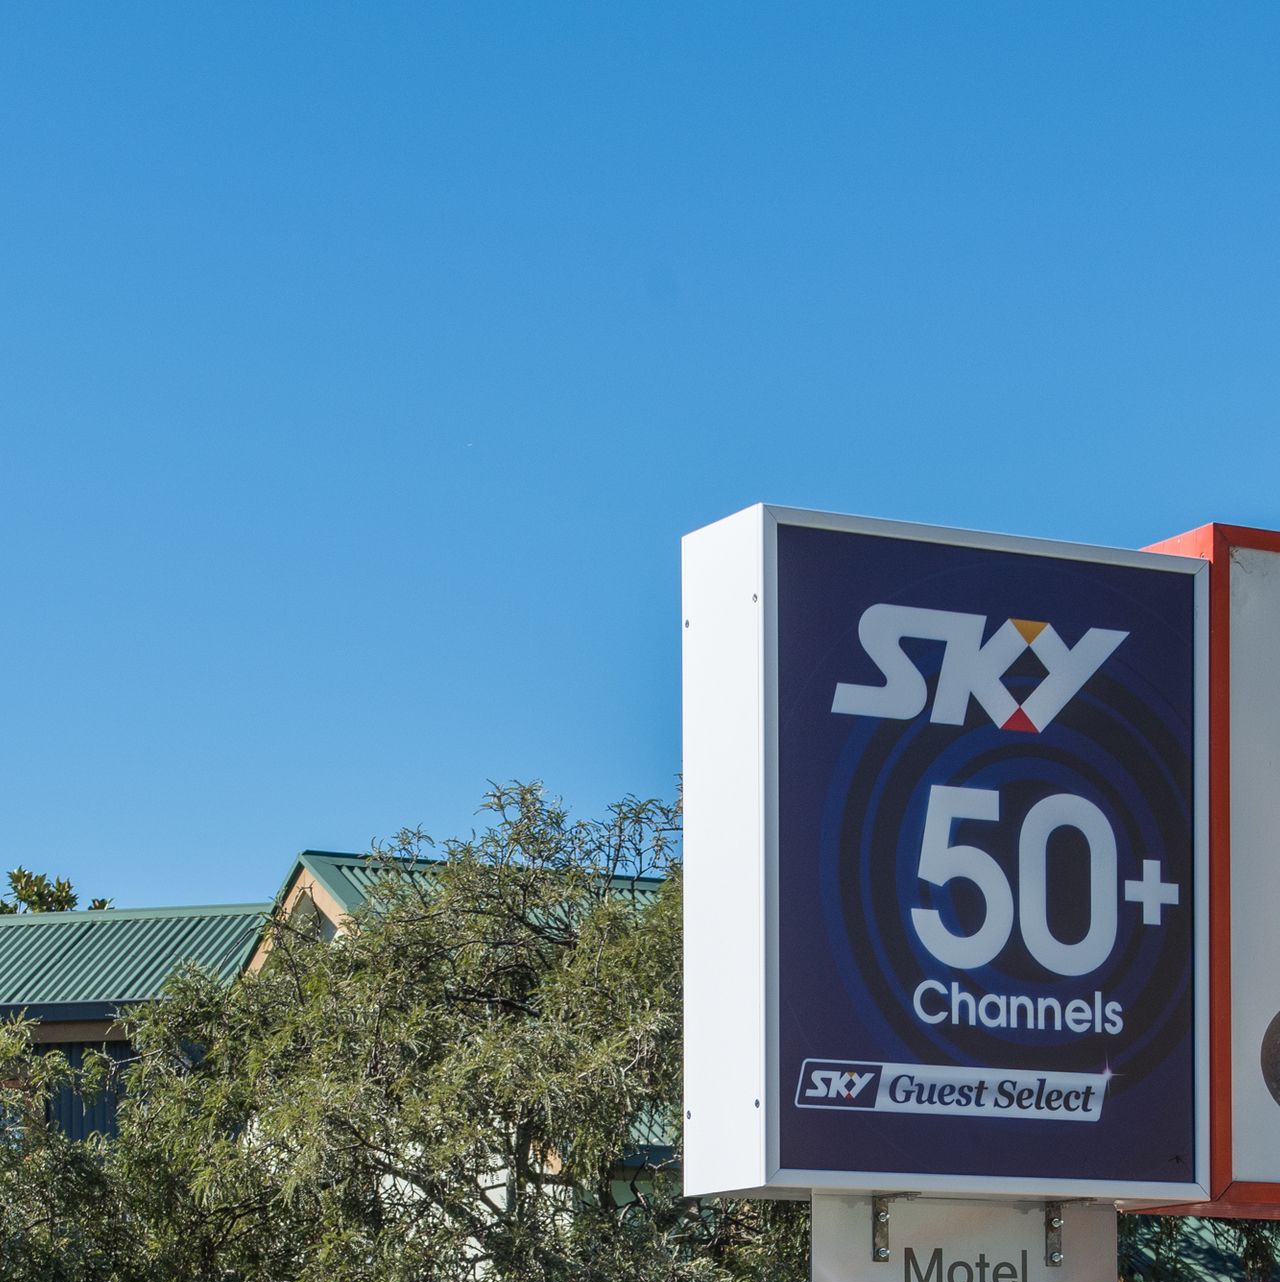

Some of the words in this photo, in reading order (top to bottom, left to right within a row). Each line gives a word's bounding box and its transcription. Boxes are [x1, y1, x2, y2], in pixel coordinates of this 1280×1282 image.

[831, 603, 1130, 733] SKY
[911, 784, 1180, 976] 50+
[913, 980, 1124, 1035] Channels
[805, 1070, 875, 1099] SKY
[888, 1074, 986, 1107] Guest
[994, 1078, 1095, 1112] Select
